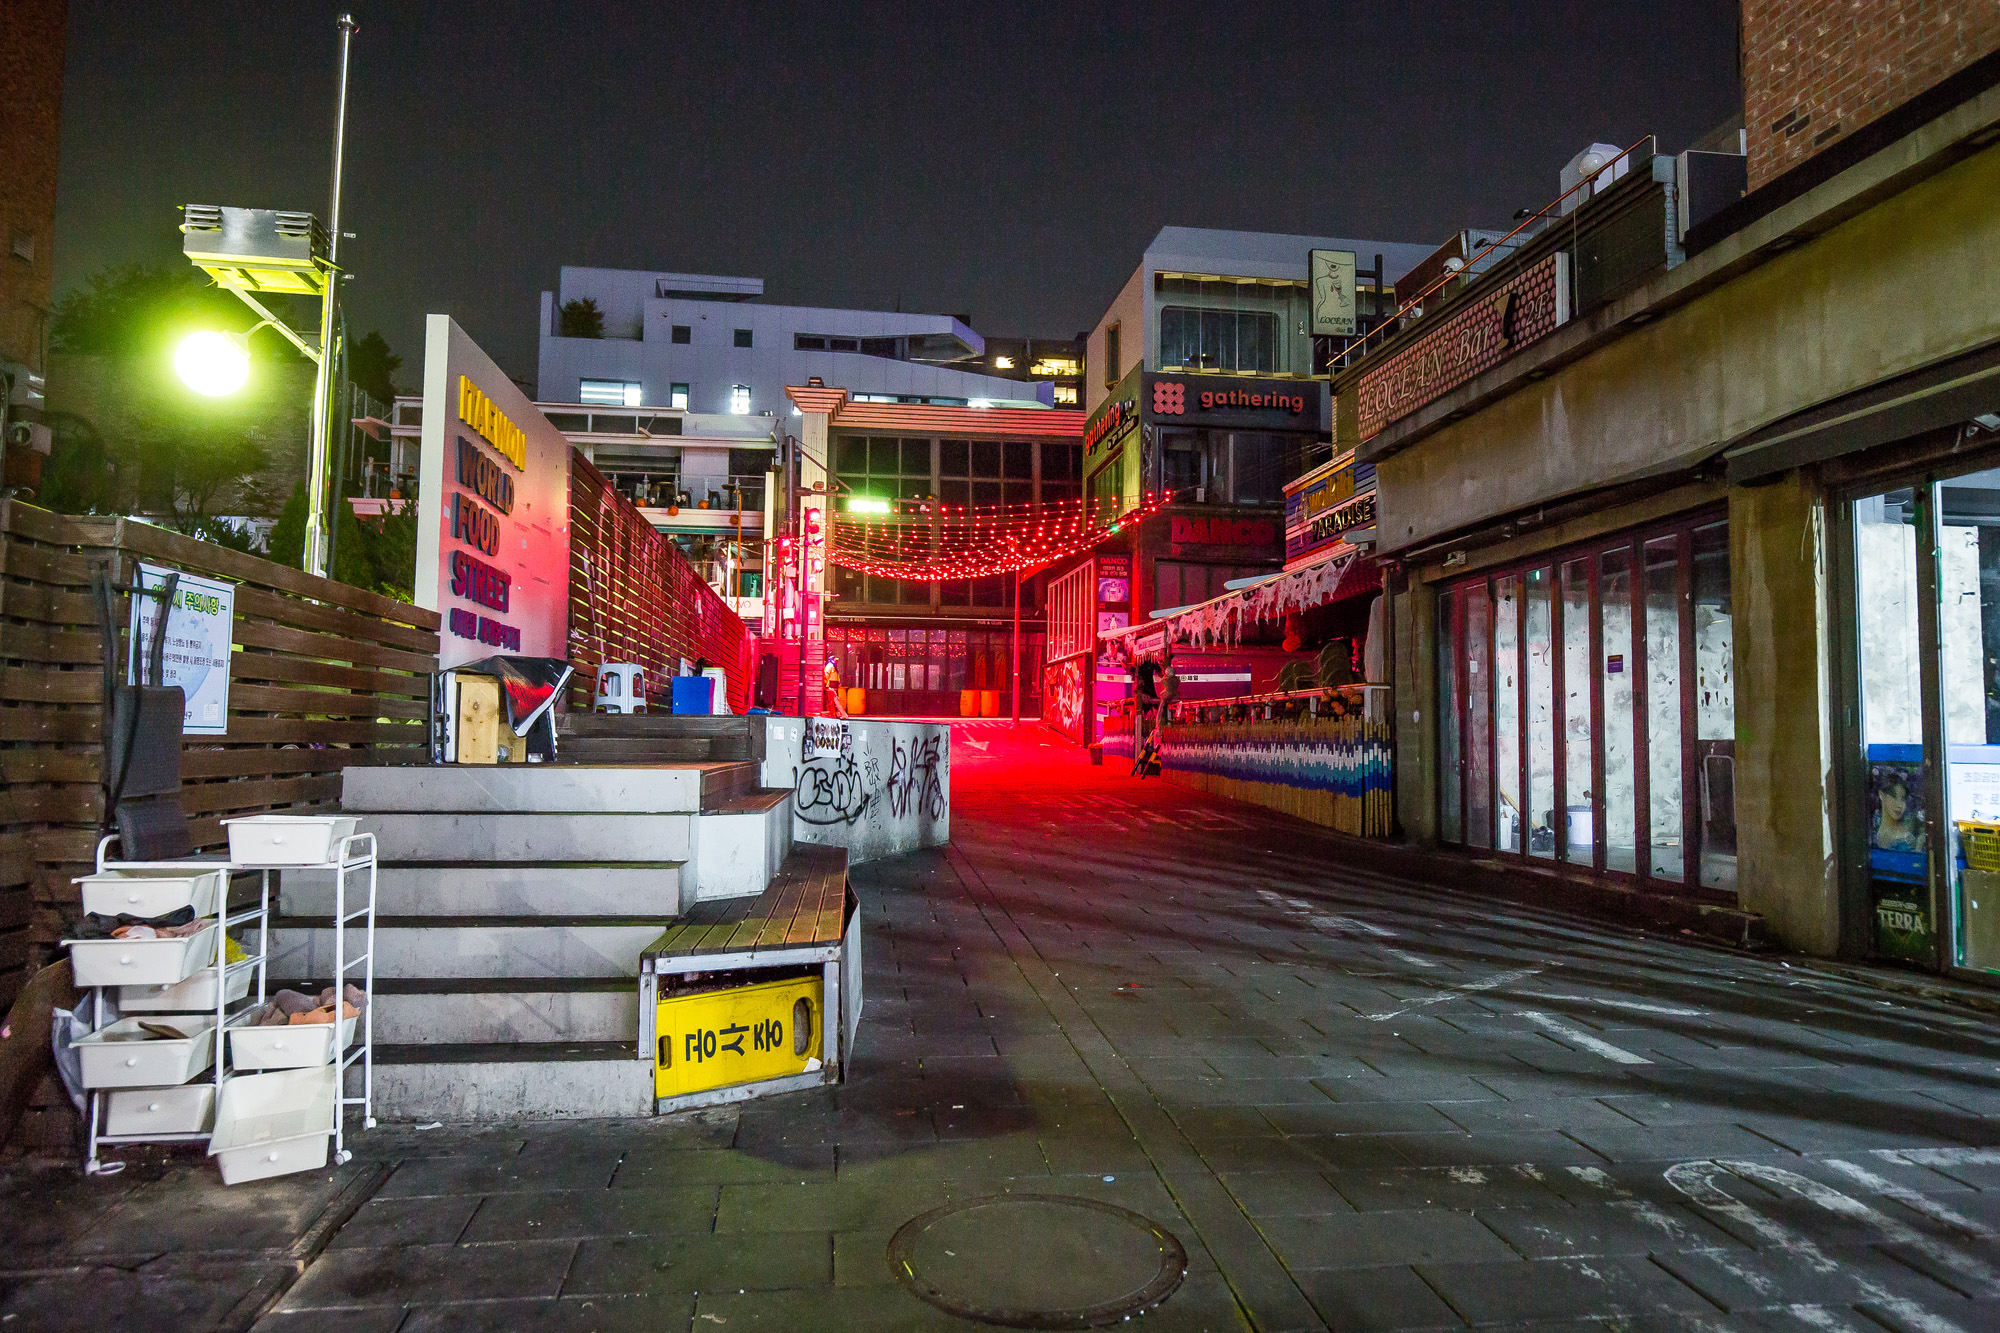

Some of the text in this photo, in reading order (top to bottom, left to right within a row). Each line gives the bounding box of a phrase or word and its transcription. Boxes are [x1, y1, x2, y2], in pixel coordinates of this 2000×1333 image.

[1454, 321, 1494, 367] Bar
[1525, 290, 1550, 327] 2F
[459, 375, 526, 472] ITAEWON
[1201, 389, 1304, 413] gathering
[1085, 401, 1120, 457] gathering
[456, 435, 514, 515] WORLD
[451, 492, 500, 557] FOOD
[1171, 516, 1275, 546] DANCO
[1310, 496, 1371, 541] PARADISE
[449, 550, 511, 613] STREET
[1100, 557, 1128, 565] DANCO
[185, 591, 219, 616] 주의사항
[1877, 908, 1925, 935] TERRA
